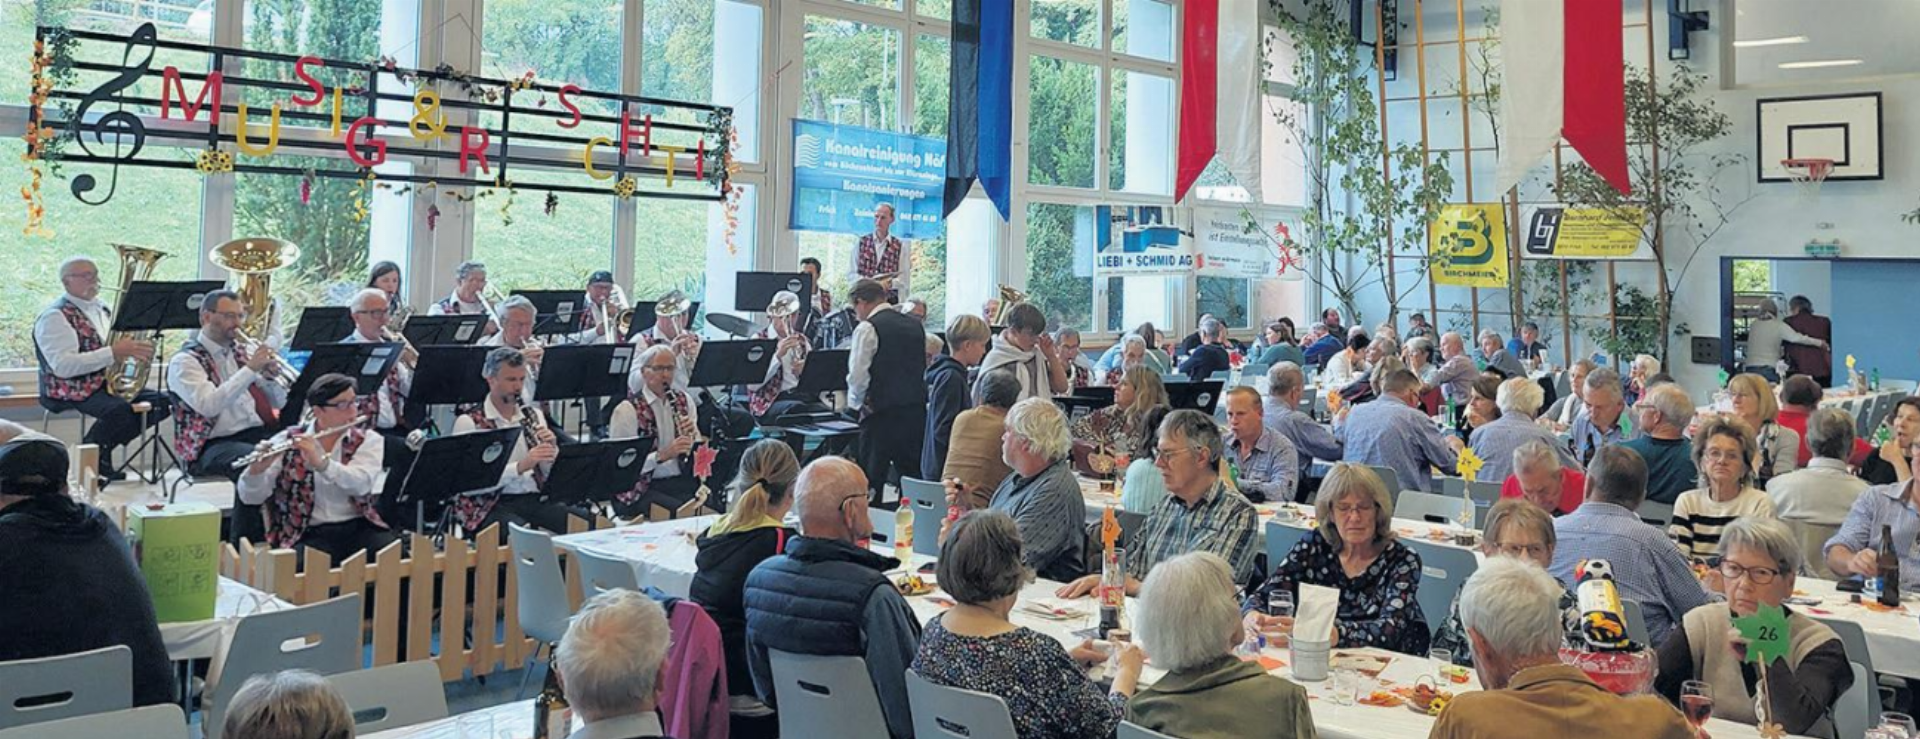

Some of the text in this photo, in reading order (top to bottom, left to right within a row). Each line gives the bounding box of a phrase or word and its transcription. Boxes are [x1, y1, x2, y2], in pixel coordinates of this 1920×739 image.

[825, 138, 922, 168] Kanalreinigung
[842, 179, 926, 199] Kanalsanierungen
[1097, 255, 1124, 268] LIEBI
[1136, 254, 1176, 268] SCHMID
[1179, 254, 1194, 267] AG
[1758, 625, 1779, 642] 26
